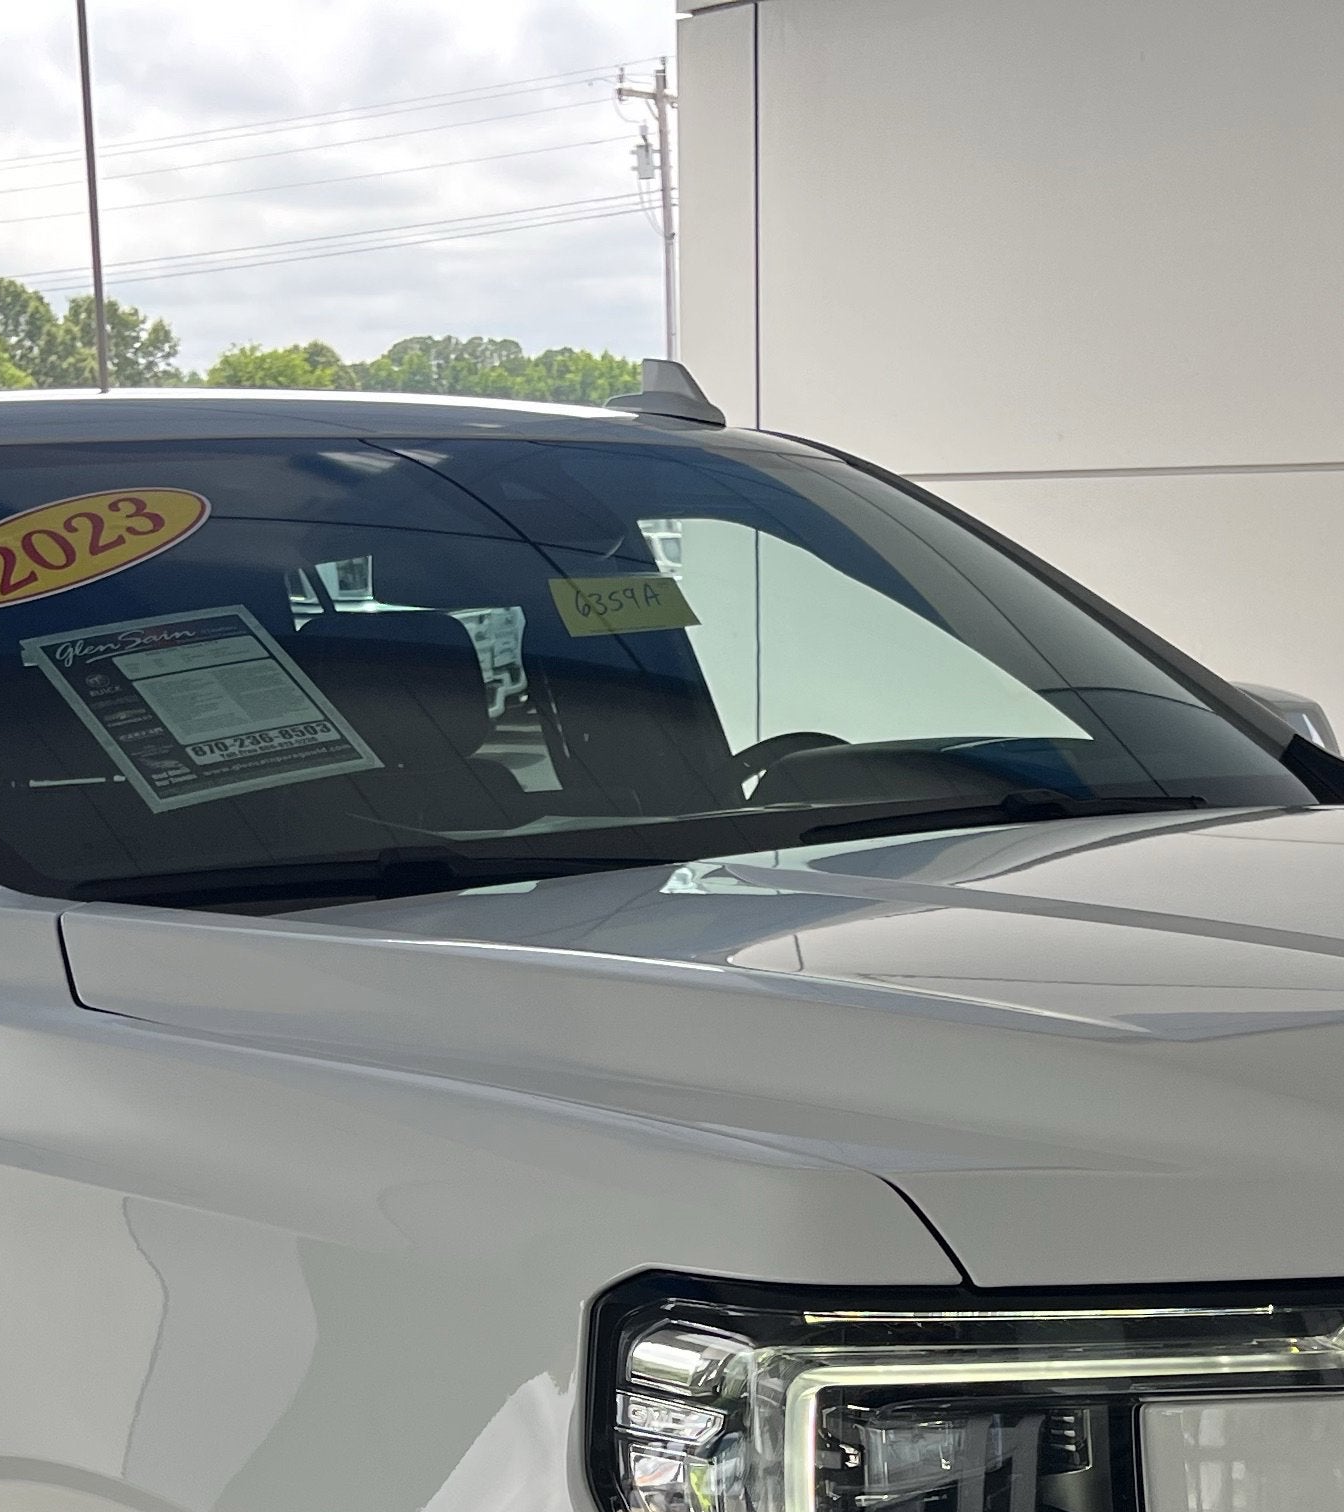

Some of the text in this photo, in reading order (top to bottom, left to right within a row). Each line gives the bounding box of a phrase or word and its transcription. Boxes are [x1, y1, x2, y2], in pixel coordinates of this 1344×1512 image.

[575, 583, 662, 618] 6359A
[55, 640, 122, 668] Glen
[117, 629, 196, 650] Sain
